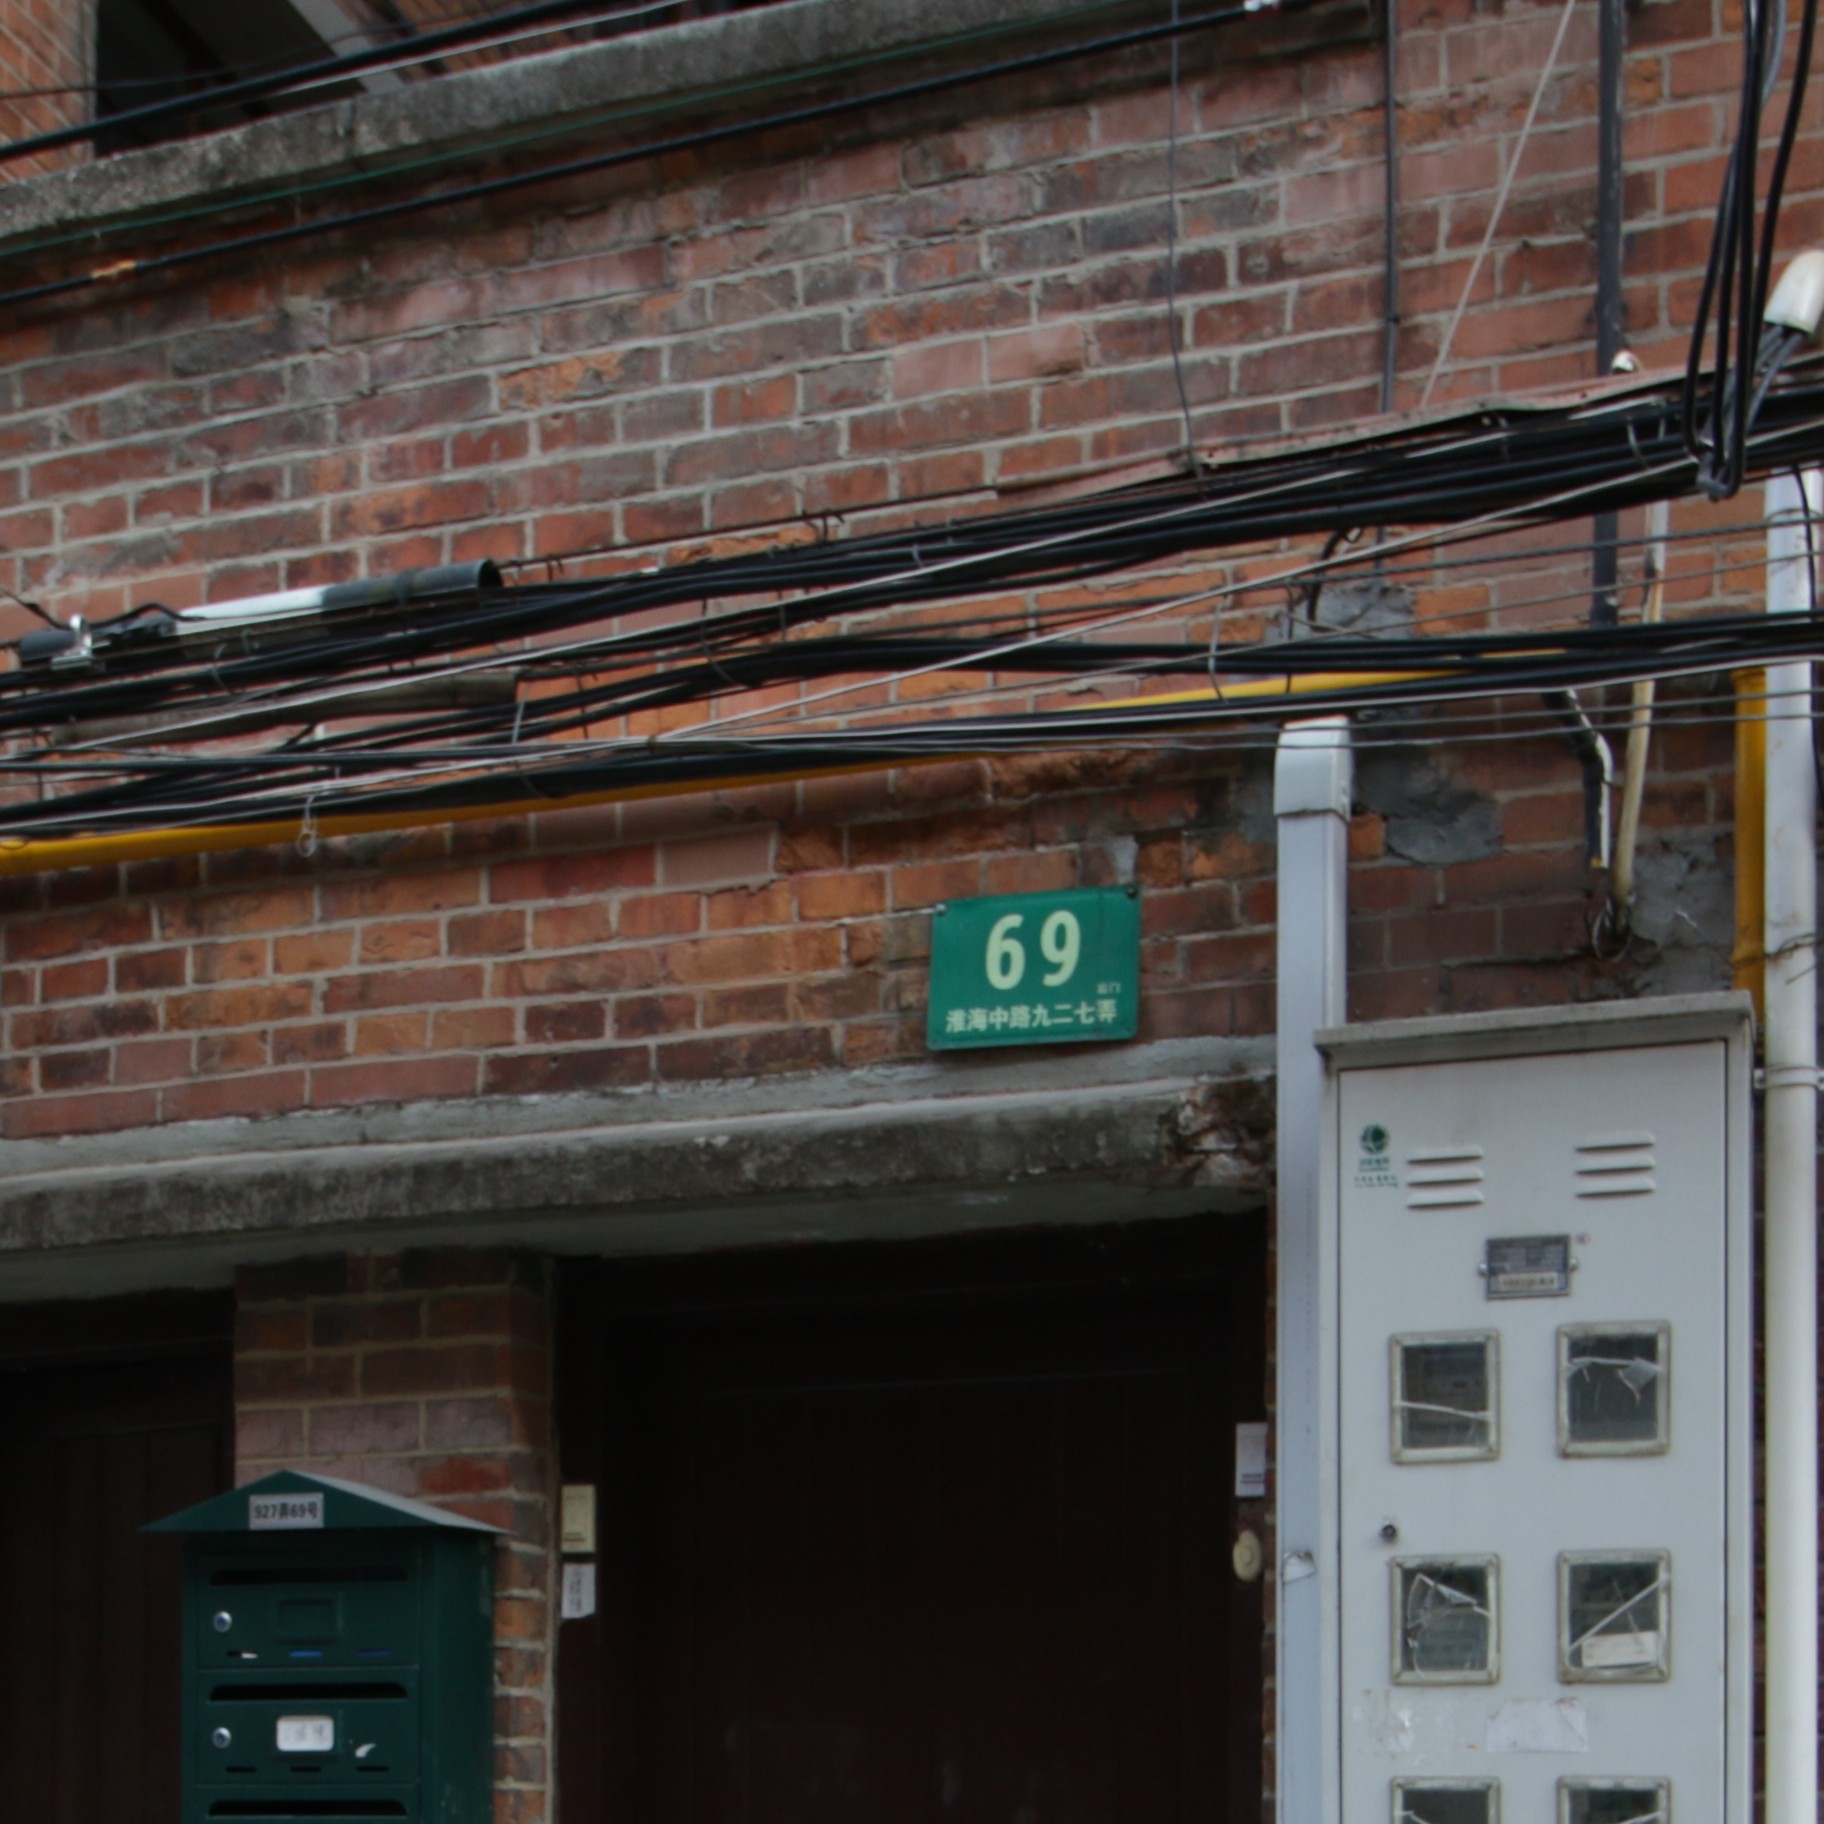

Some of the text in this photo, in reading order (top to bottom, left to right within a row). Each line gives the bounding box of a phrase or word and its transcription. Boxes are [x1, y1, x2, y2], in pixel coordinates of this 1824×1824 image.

[985, 909, 1082, 991] 69
[945, 998, 1118, 1034] 淮海中路九二七弄
